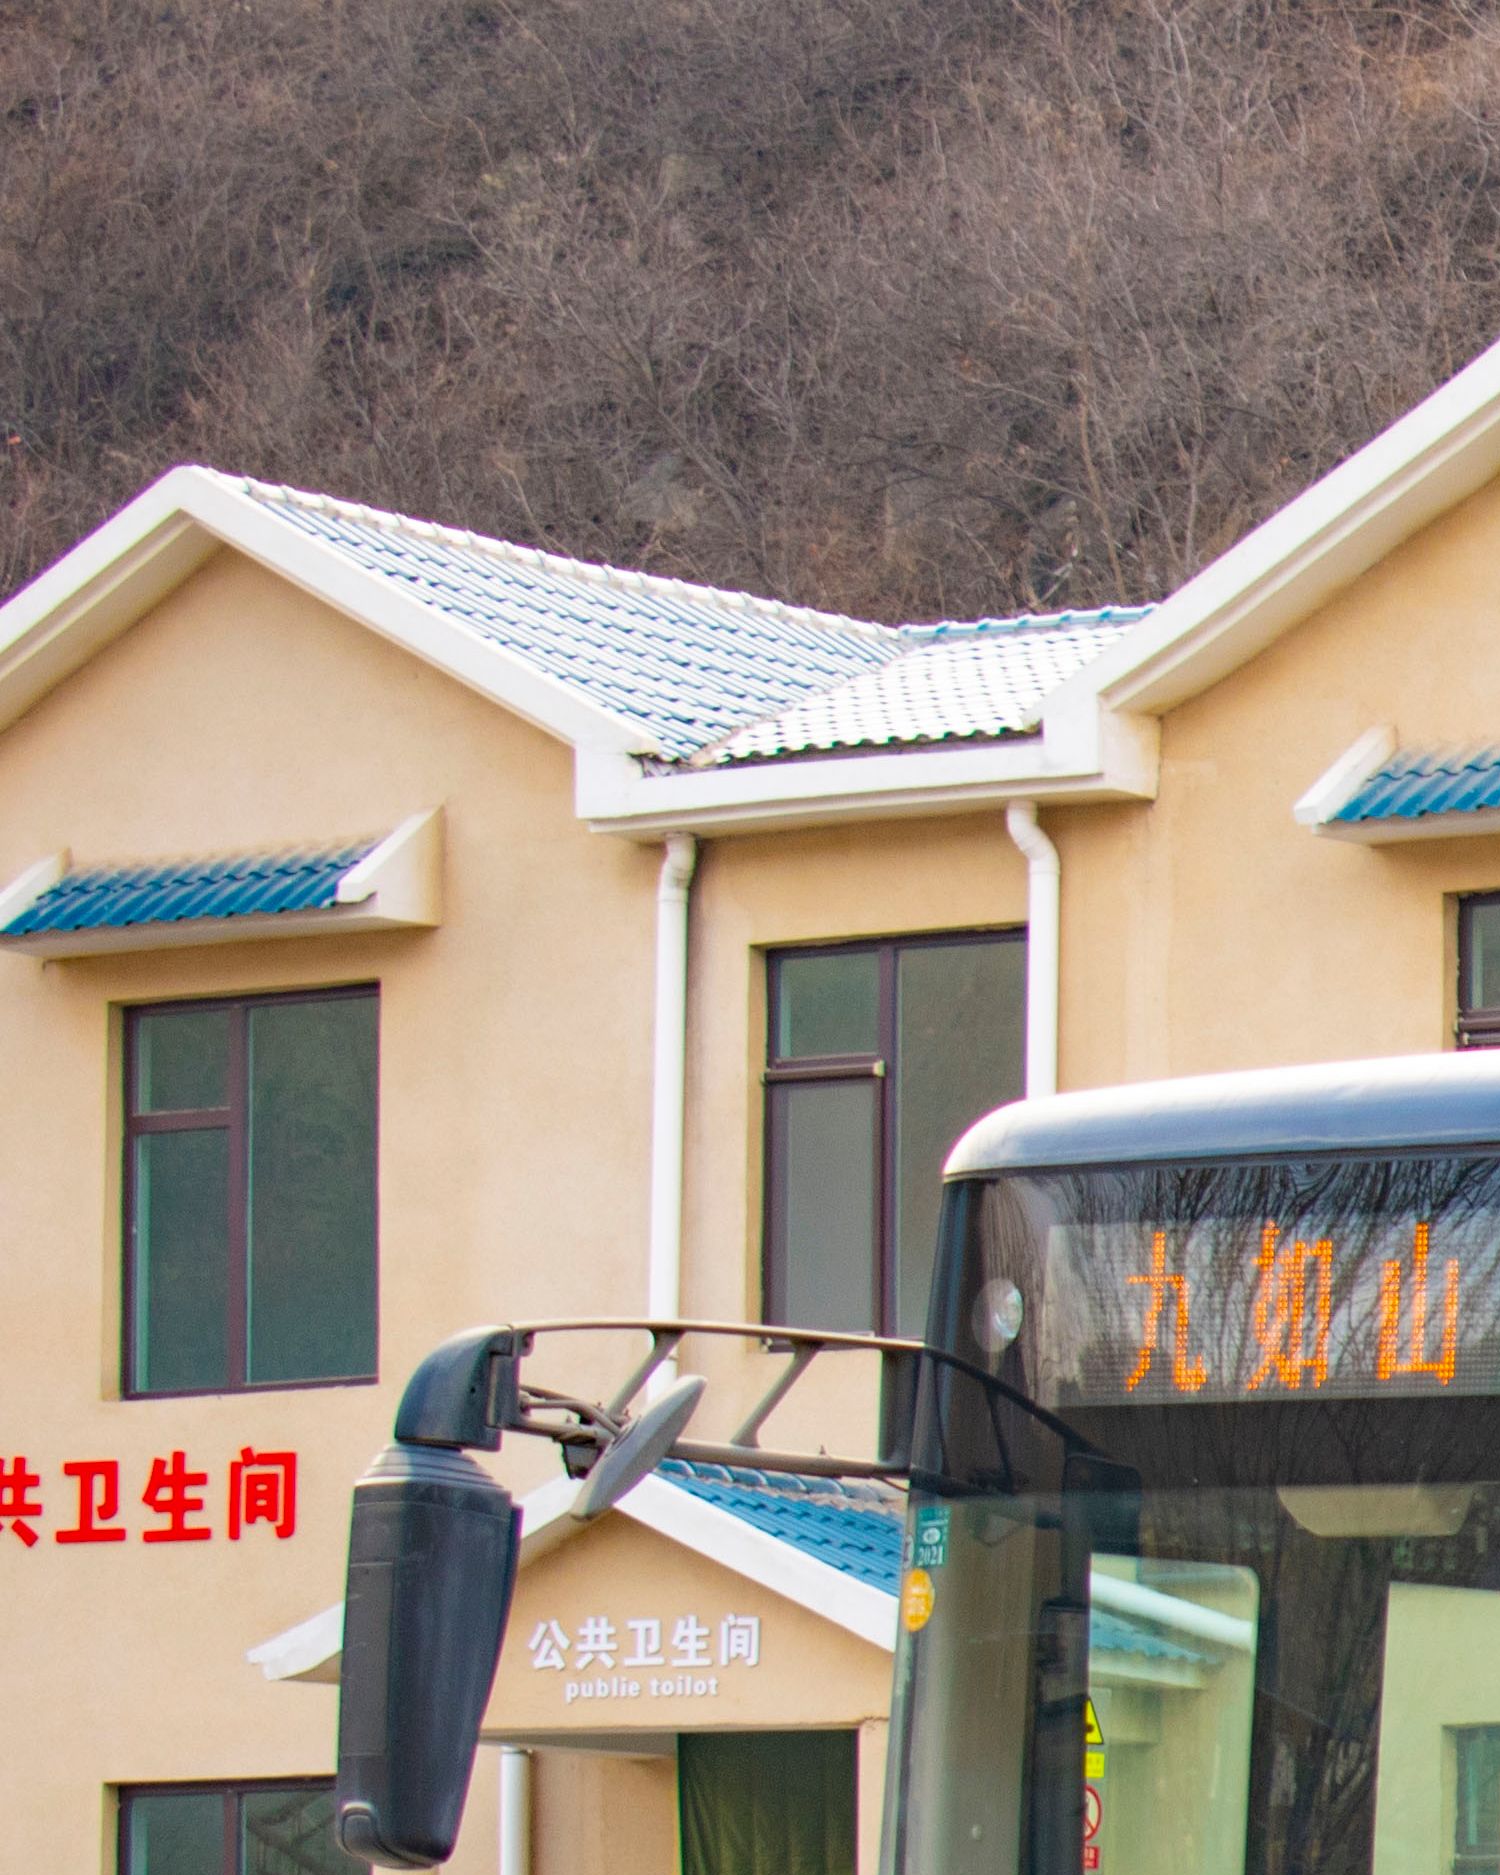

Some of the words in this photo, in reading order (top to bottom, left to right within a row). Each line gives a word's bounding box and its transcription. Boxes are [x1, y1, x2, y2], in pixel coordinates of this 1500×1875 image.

[1125, 1220, 1460, 1393] 九如山
[0, 1446, 297, 1547] 共卫生间
[528, 1614, 761, 1671] 公共卫生间
